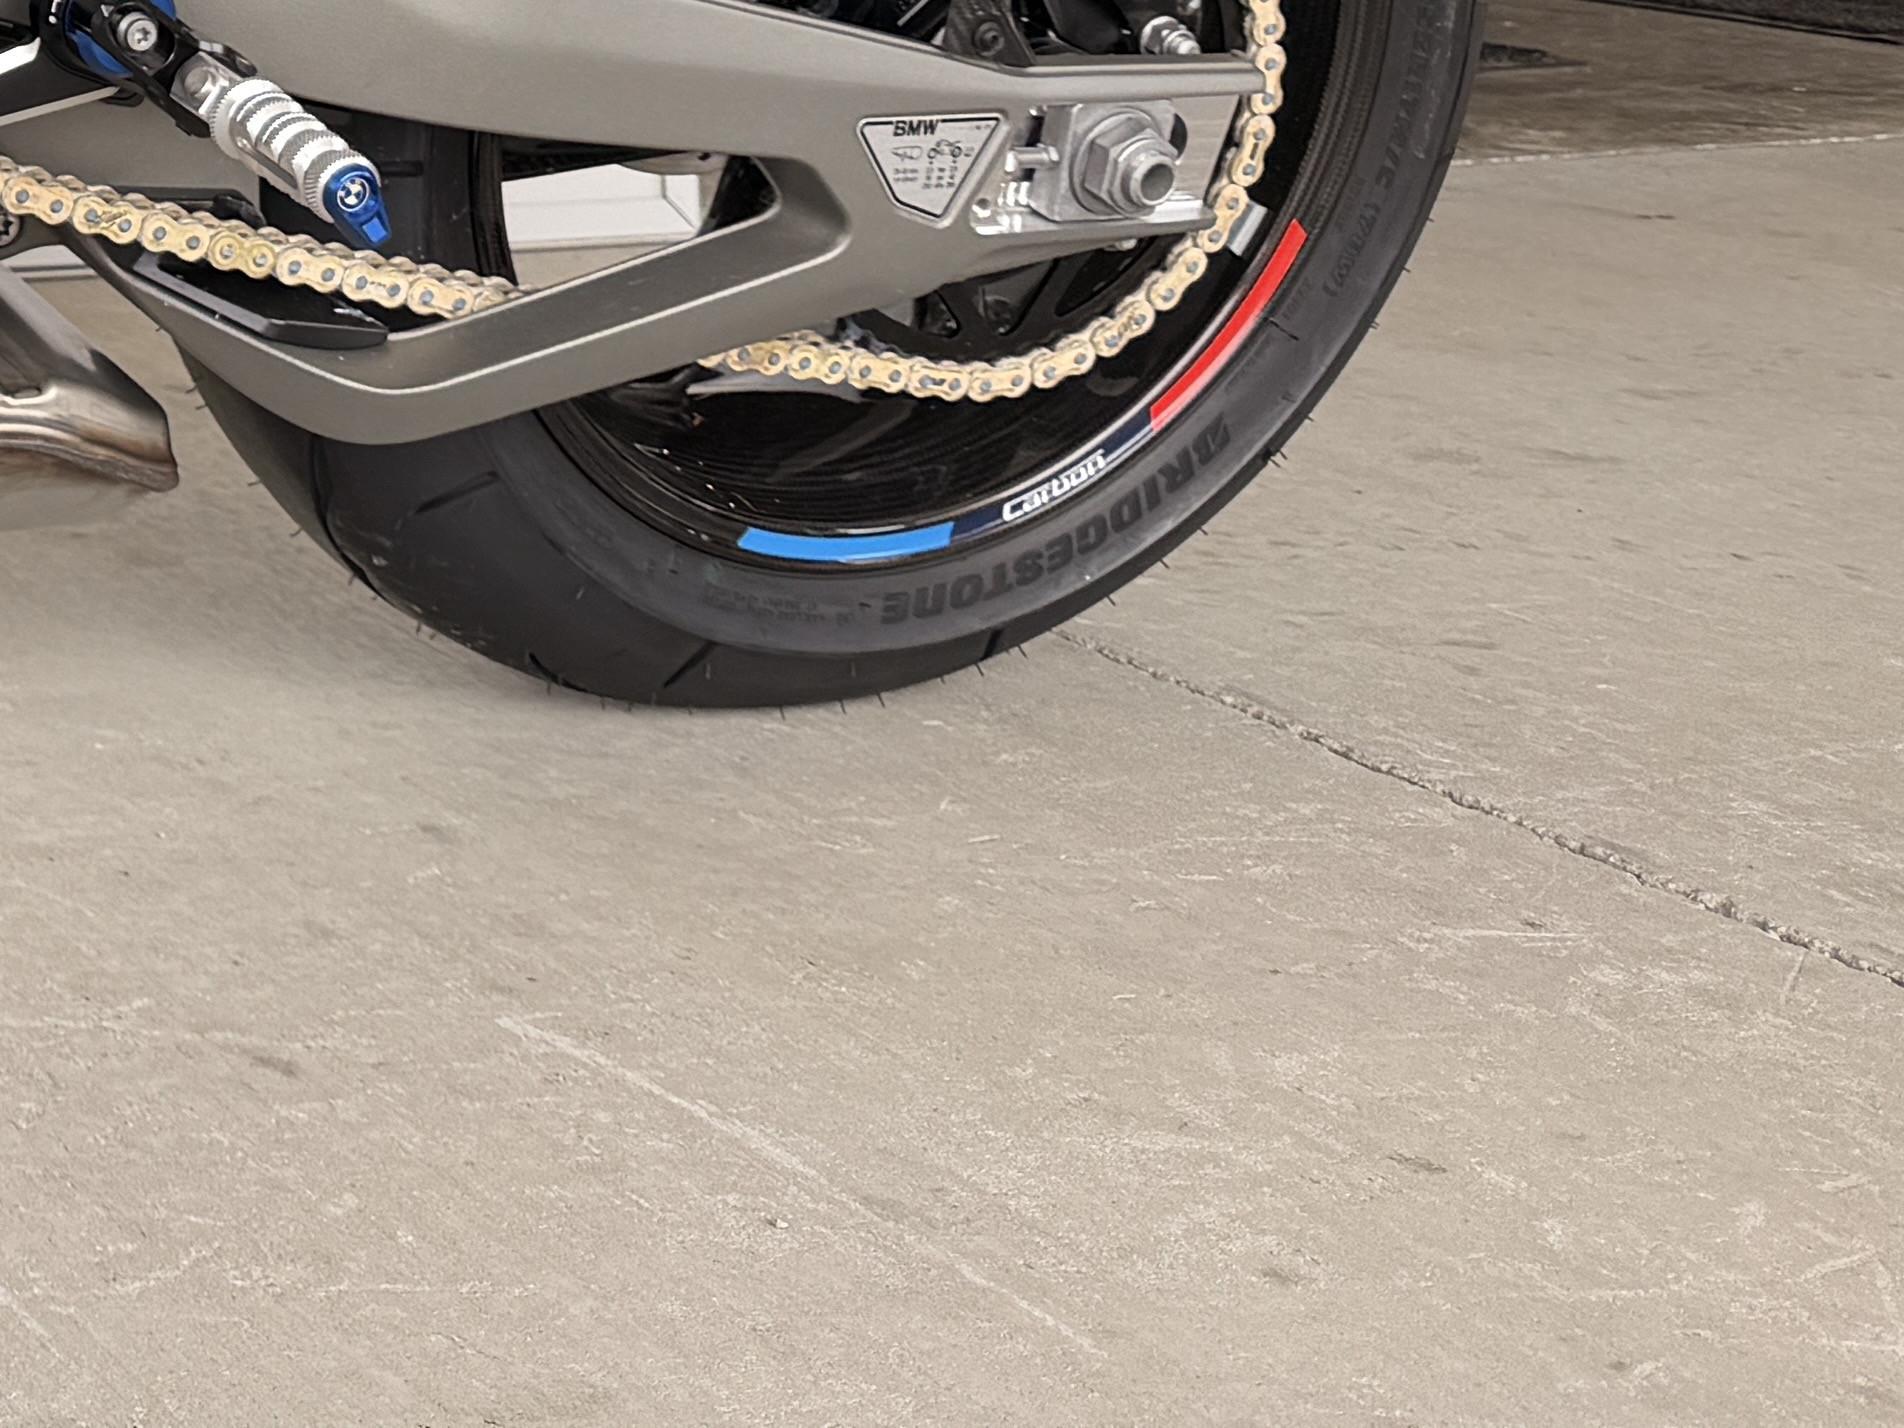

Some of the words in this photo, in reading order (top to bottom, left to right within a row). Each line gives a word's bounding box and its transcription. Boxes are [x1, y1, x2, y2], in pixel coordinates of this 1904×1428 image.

[893, 119, 940, 137] BMW
[877, 412, 1239, 628] BRIDGESTONE
[1002, 448, 1106, 522] Carbon
